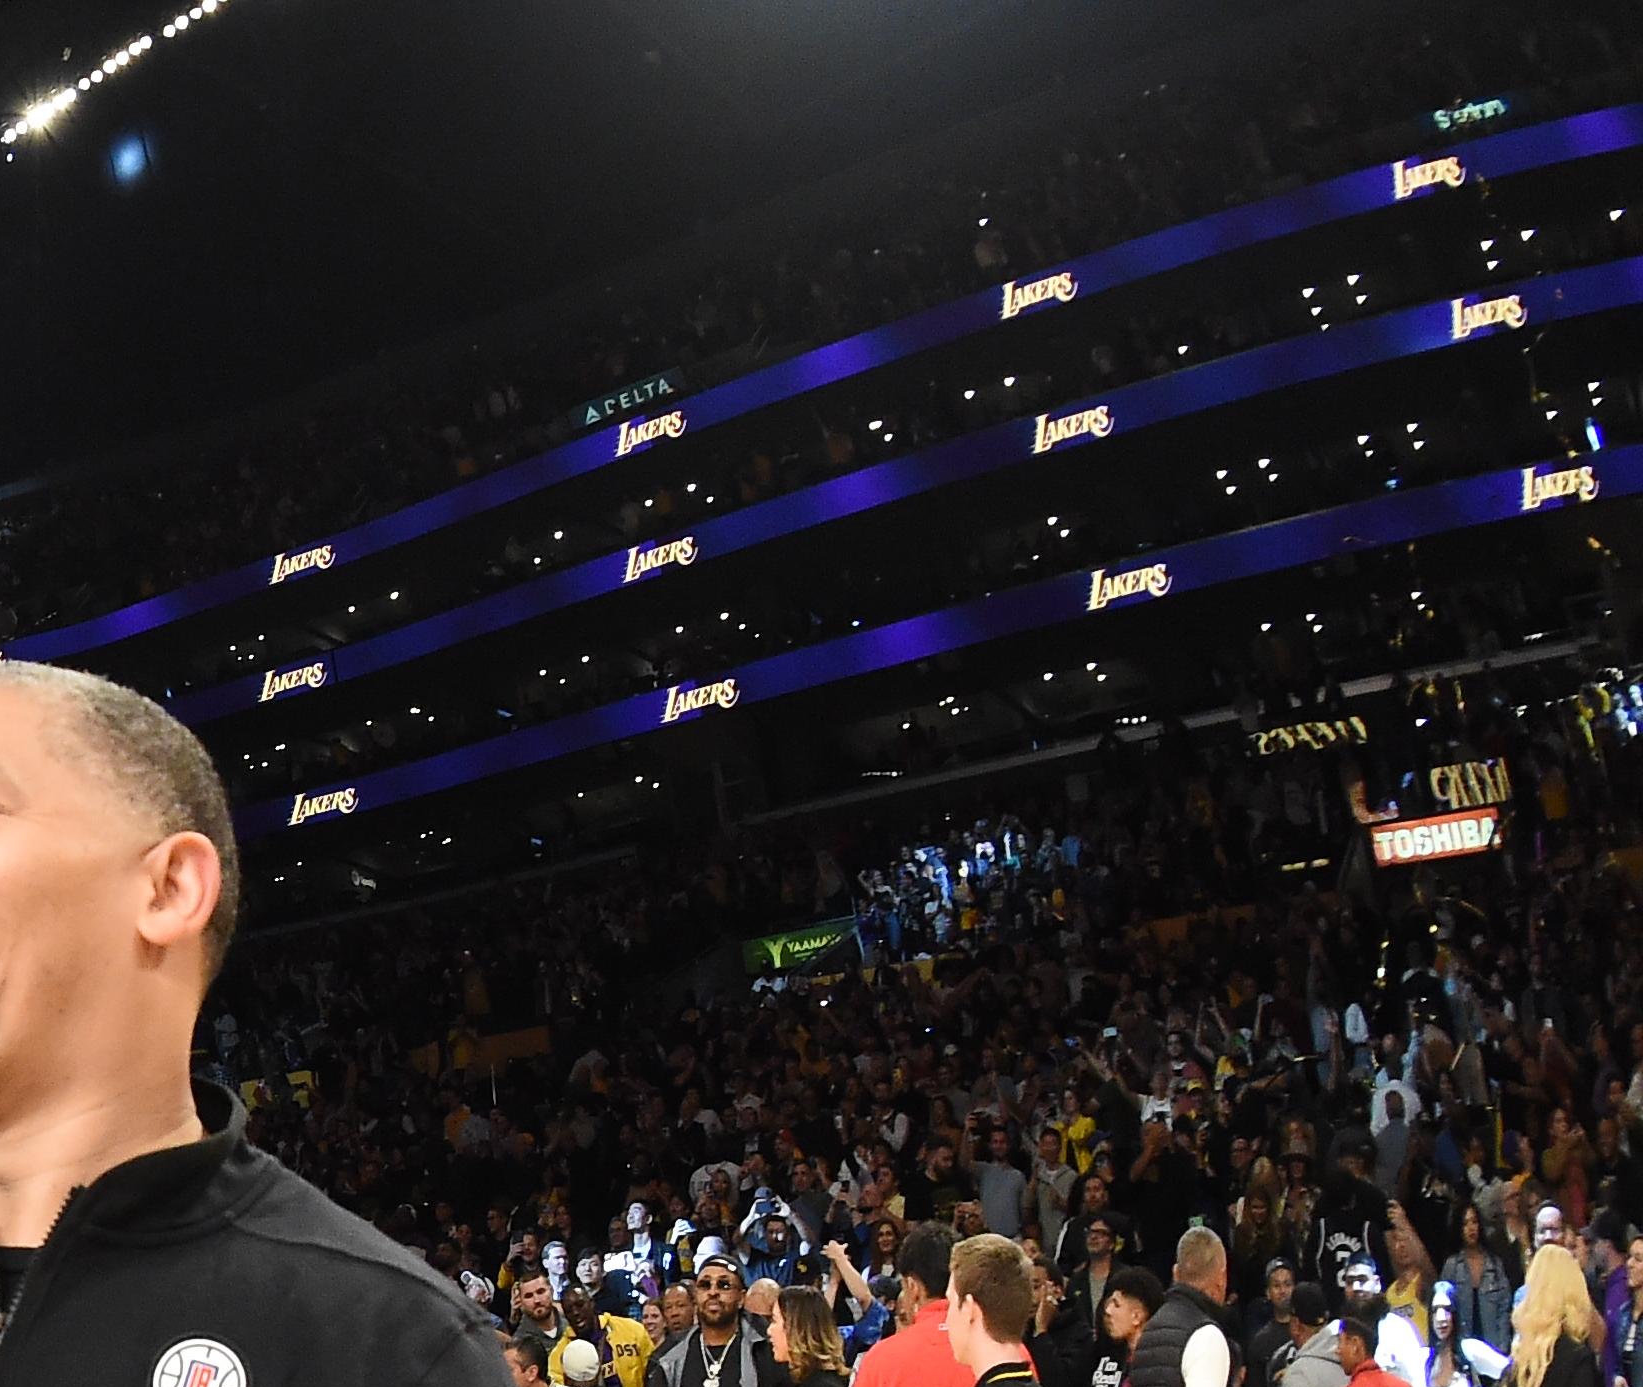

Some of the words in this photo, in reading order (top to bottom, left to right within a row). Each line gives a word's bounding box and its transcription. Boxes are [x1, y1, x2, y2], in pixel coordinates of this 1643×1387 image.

[999, 273, 1078, 319] LAKERS
[615, 410, 687, 457] LAKERS
[1031, 406, 1114, 454] LAKERS
[268, 545, 336, 585] LAKERS
[623, 537, 698, 583] LAKERS
[1086, 564, 1172, 610] LAKERS
[258, 663, 327, 702] LAKERS
[661, 679, 740, 723] LAKERS
[288, 788, 358, 826] LAKERS
[1373, 816, 1502, 861] TOSHIBA
